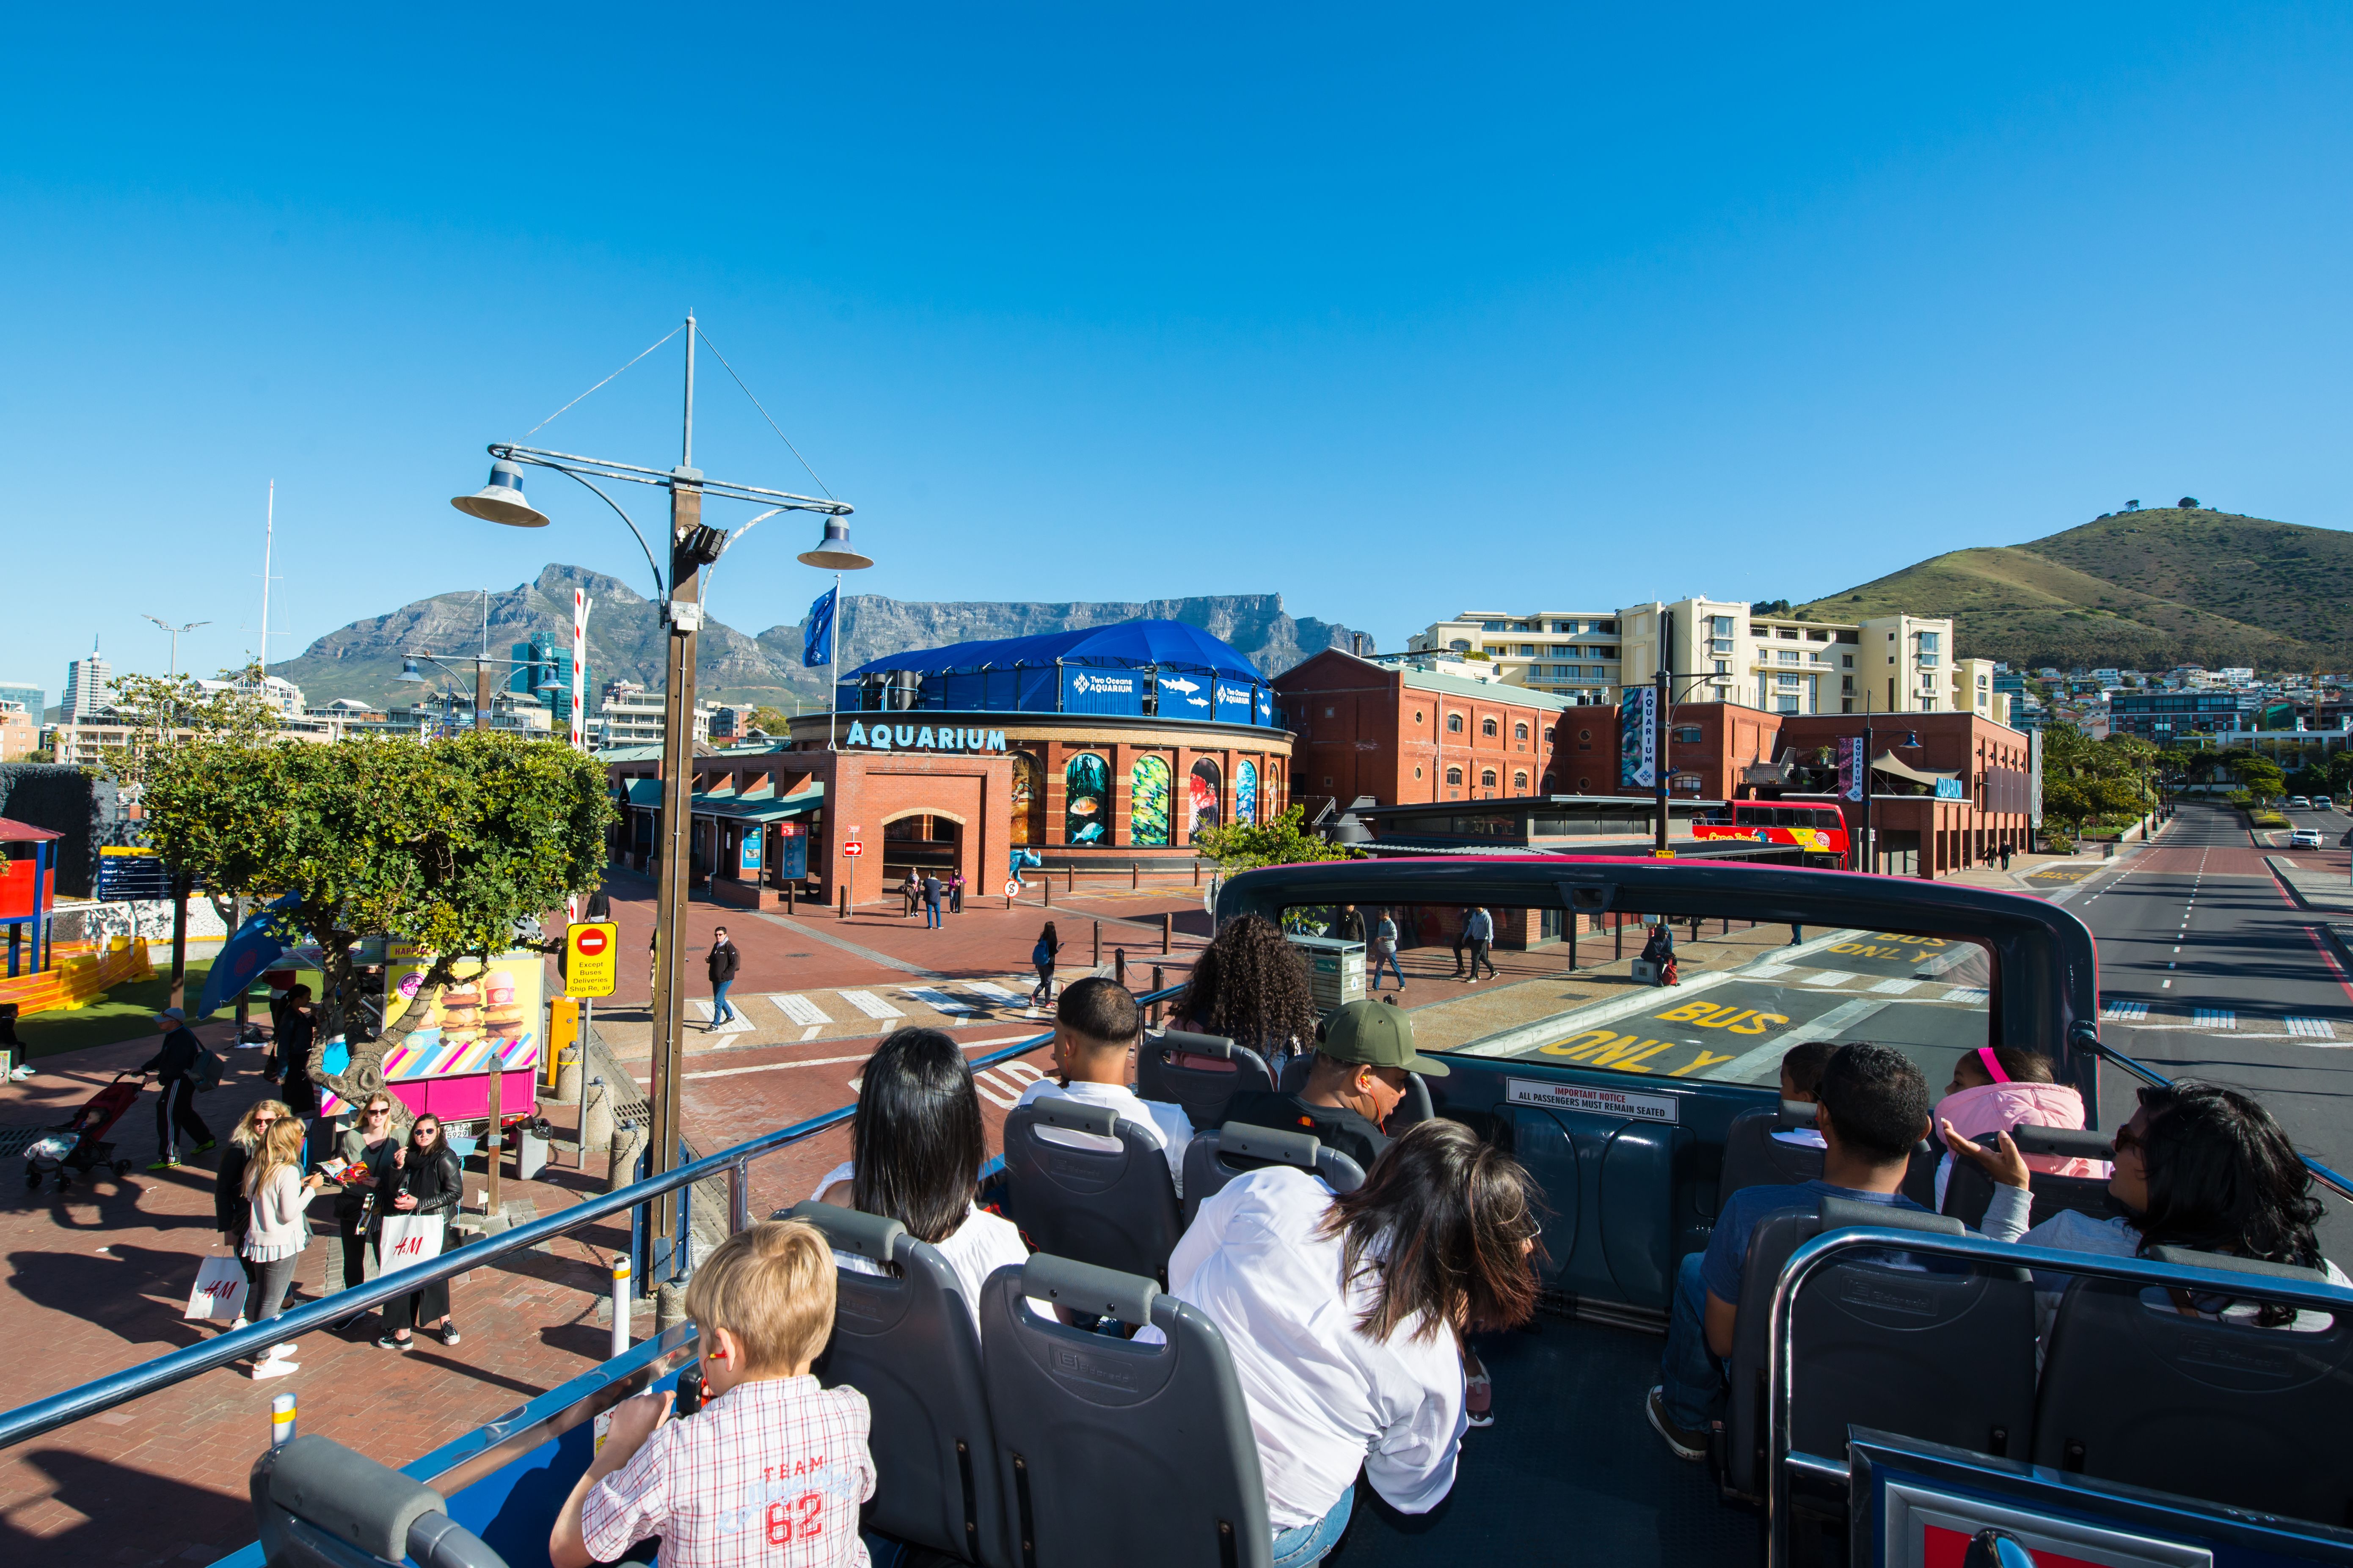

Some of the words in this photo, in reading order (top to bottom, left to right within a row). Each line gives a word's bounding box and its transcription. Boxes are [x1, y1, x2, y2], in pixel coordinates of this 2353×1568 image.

[1090, 684, 1132, 693] AQUARIUM
[1106, 677, 1132, 685] Oceans
[1226, 695, 1250, 704] AQUARIUM
[1235, 689, 1250, 698] Oceans
[1645, 690, 1653, 763] AQUARIUM
[846, 723, 1006, 751] AQUARIUM
[1937, 777, 1962, 798] AQUARIUM
[1874, 933, 1953, 946] BUS
[1827, 943, 1941, 962] ONLY
[1654, 1001, 1789, 1034] BUS
[1538, 1030, 1736, 1076] ONLY
[1519, 1092, 1532, 1100] ALL
[1534, 1093, 1579, 1106] PASSENGERS
[1582, 1100, 1602, 1110] MUST
[1604, 1103, 1634, 1114] REMAIN
[1637, 1106, 1665, 1117] SEATED
[1555, 1087, 1597, 1100] IMPORTANT
[1599, 1093, 1626, 1103] NOTICE
[447, 1131, 466, 1139] 5929
[393, 1236, 423, 1256] H&M
[201, 1280, 237, 1300] H&M
[764, 1455, 823, 1483] TEAM
[766, 1491, 824, 1548] 62
